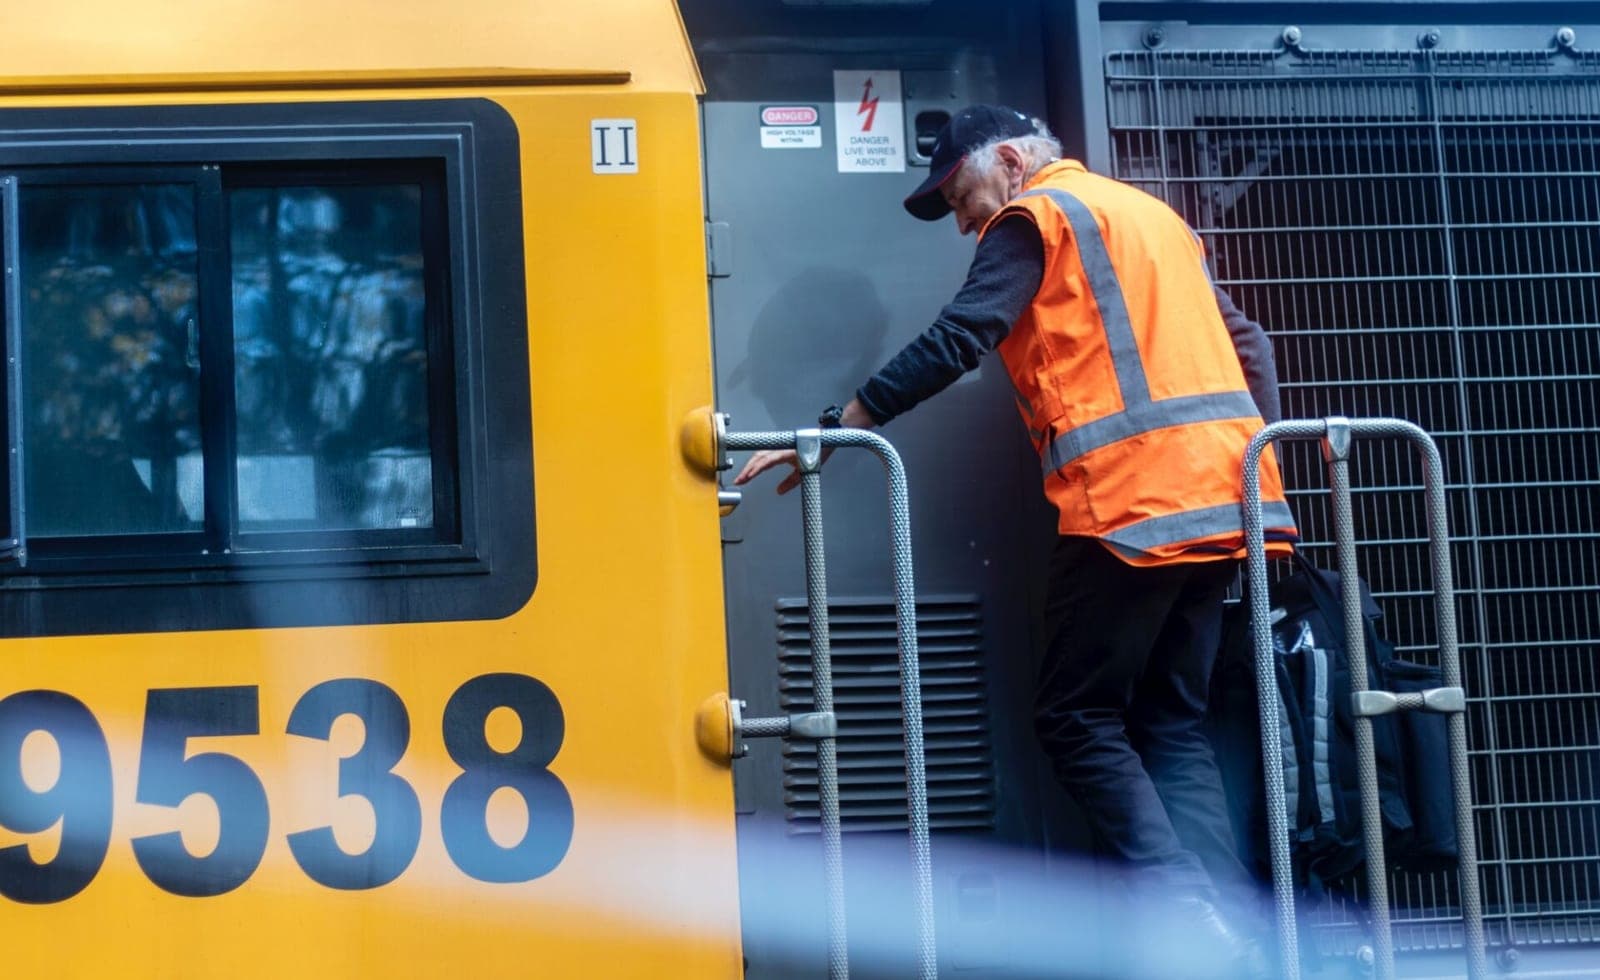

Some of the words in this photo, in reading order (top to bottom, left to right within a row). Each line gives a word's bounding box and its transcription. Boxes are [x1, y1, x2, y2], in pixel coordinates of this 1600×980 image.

[767, 111, 812, 121] DANGER
[850, 136, 889, 145] DANGER
[844, 147, 864, 156] LIVE
[866, 147, 897, 155] WIRES
[856, 158, 887, 166] ABOVE
[0, 672, 574, 905] 9538
